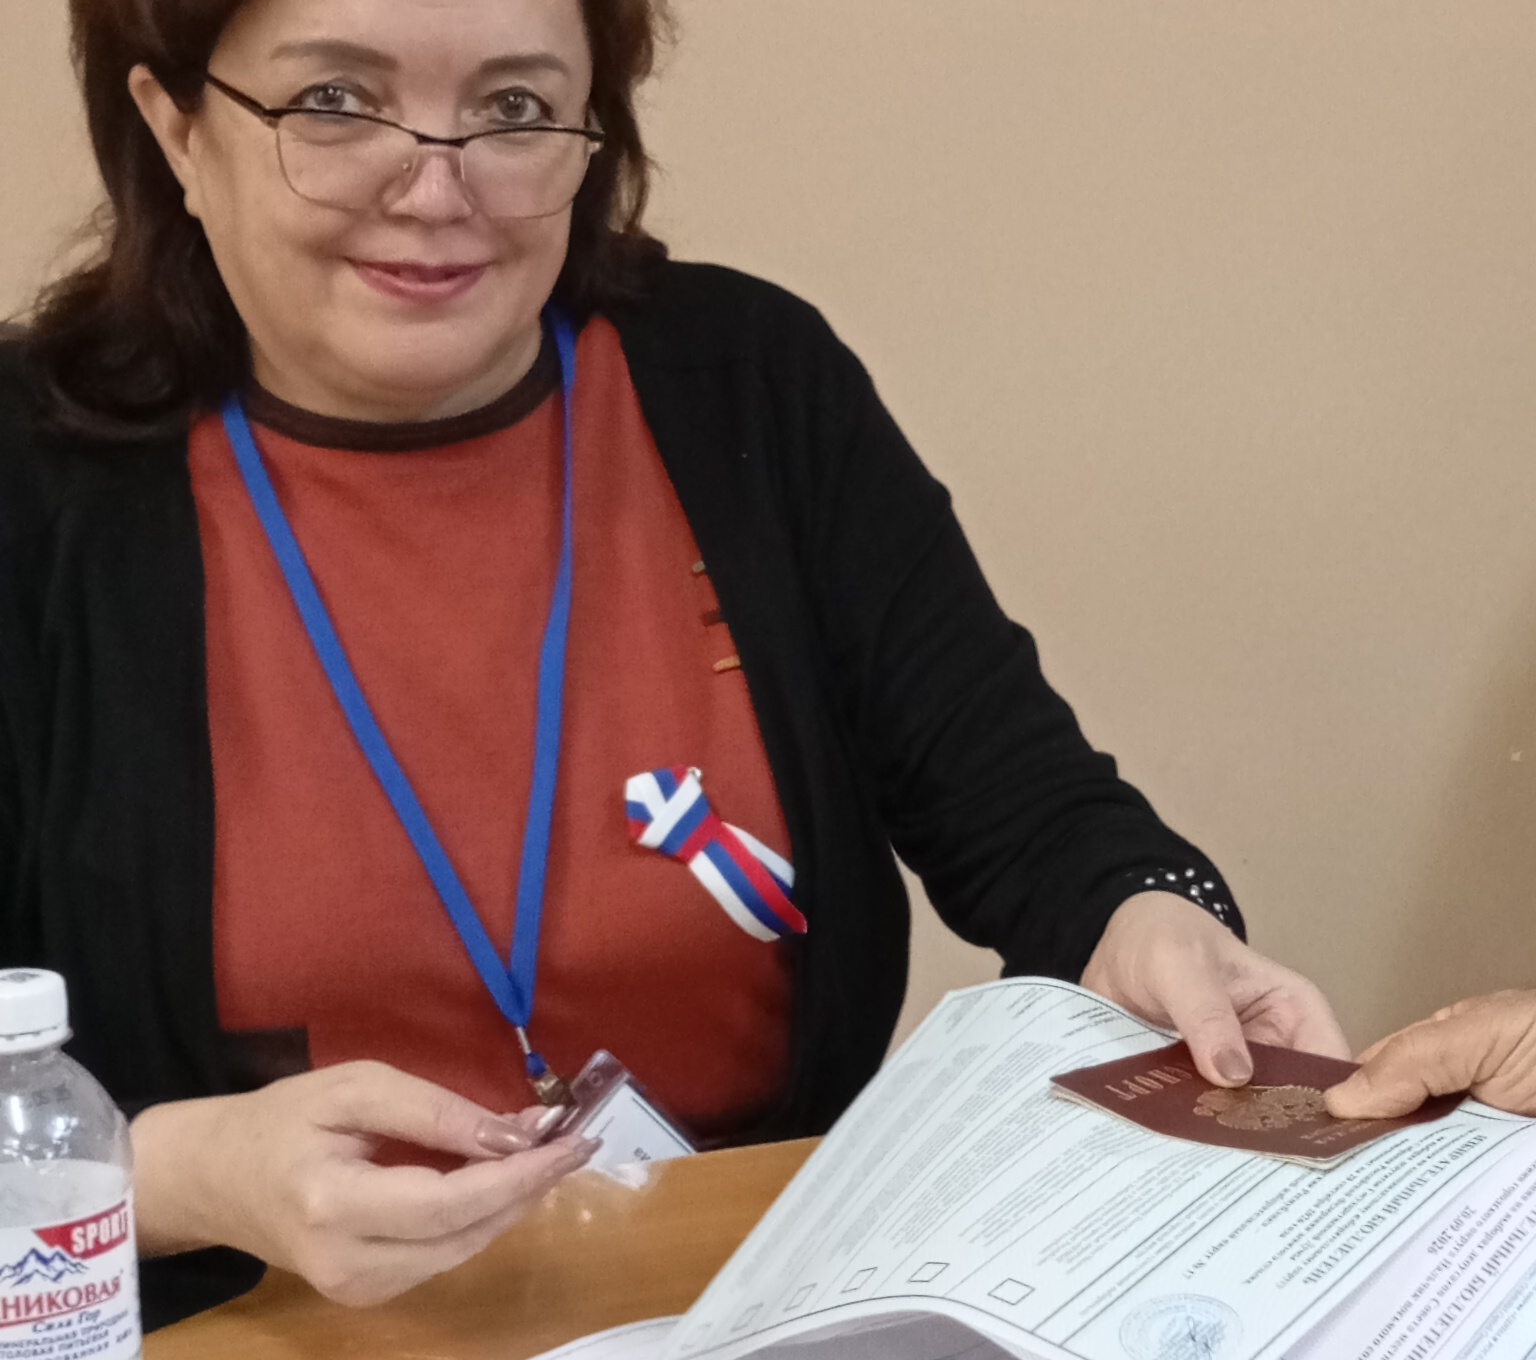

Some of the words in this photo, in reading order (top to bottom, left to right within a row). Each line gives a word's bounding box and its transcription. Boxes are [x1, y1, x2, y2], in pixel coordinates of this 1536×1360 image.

[1301, 1209, 1386, 1290] БЮЛЛЕТЕНЬ
[0, 1275, 121, 1322] НИКОВАЯ
[1410, 1256, 1451, 1302] Нальчик
[0, 1346, 53, 1360] ТОЛОВАЯ
